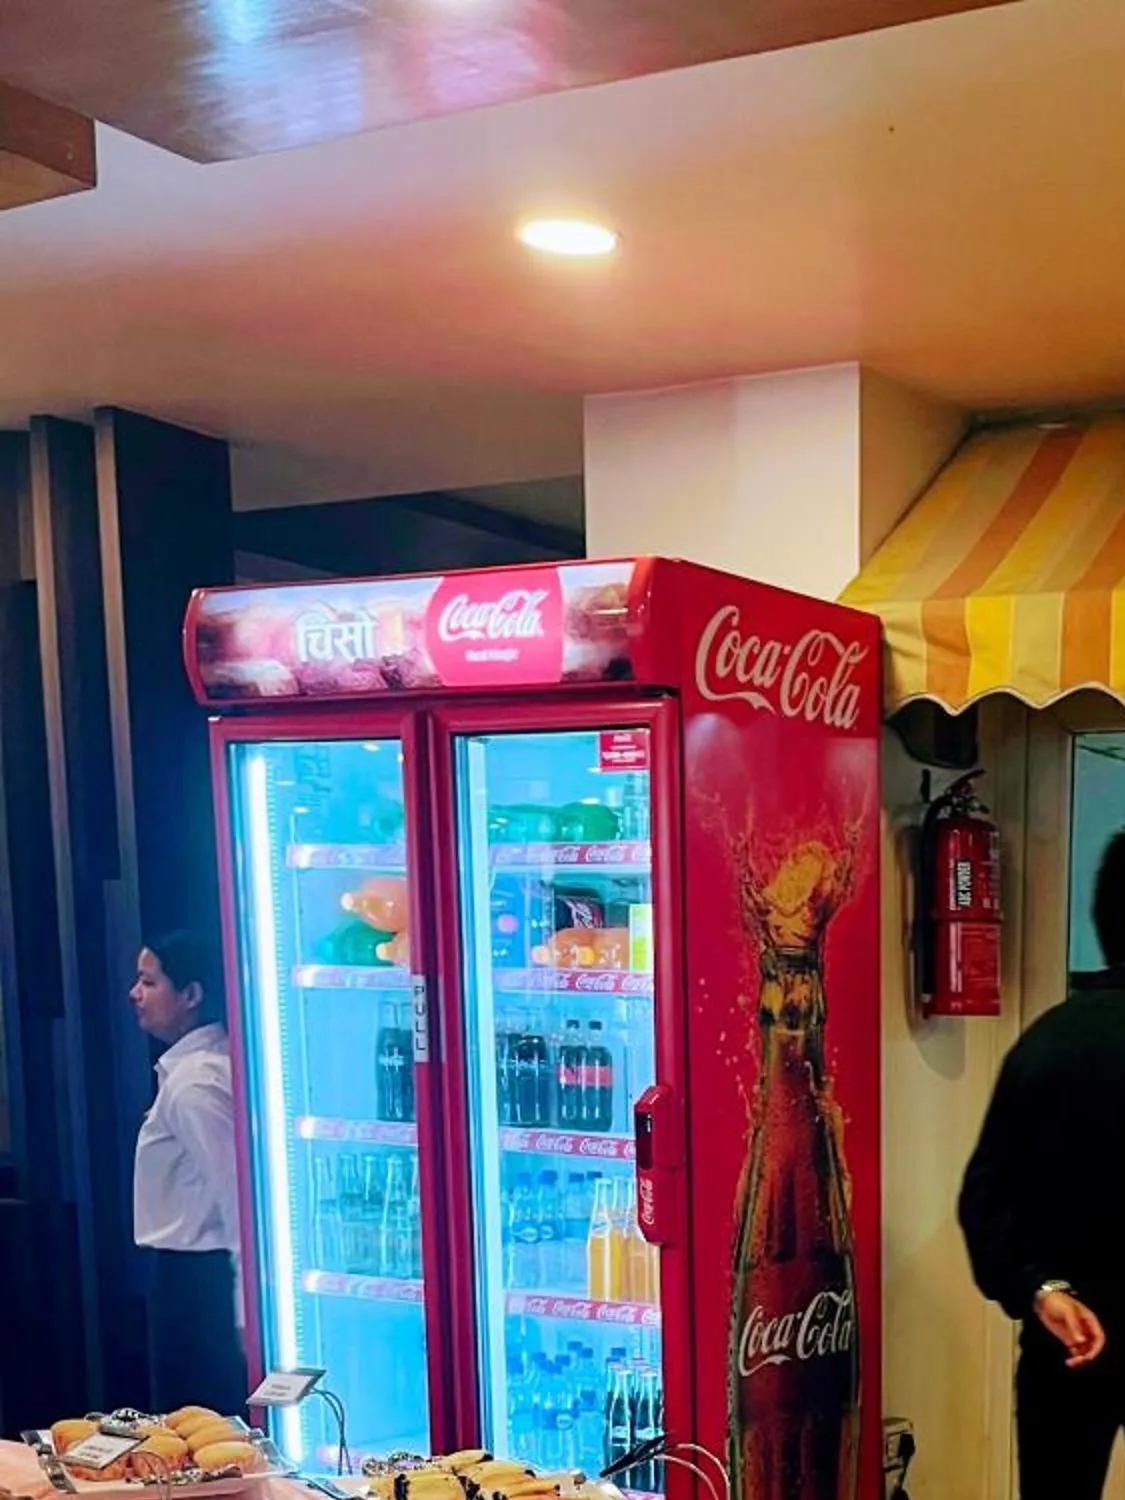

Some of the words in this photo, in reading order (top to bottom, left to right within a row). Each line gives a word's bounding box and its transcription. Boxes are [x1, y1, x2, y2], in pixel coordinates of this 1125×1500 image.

[438, 589, 549, 642] Coca-Cola
[695, 604, 870, 731] Coca-Cola
[415, 985, 427, 1051] PULL
[739, 1289, 855, 1378] Coca-Cola
